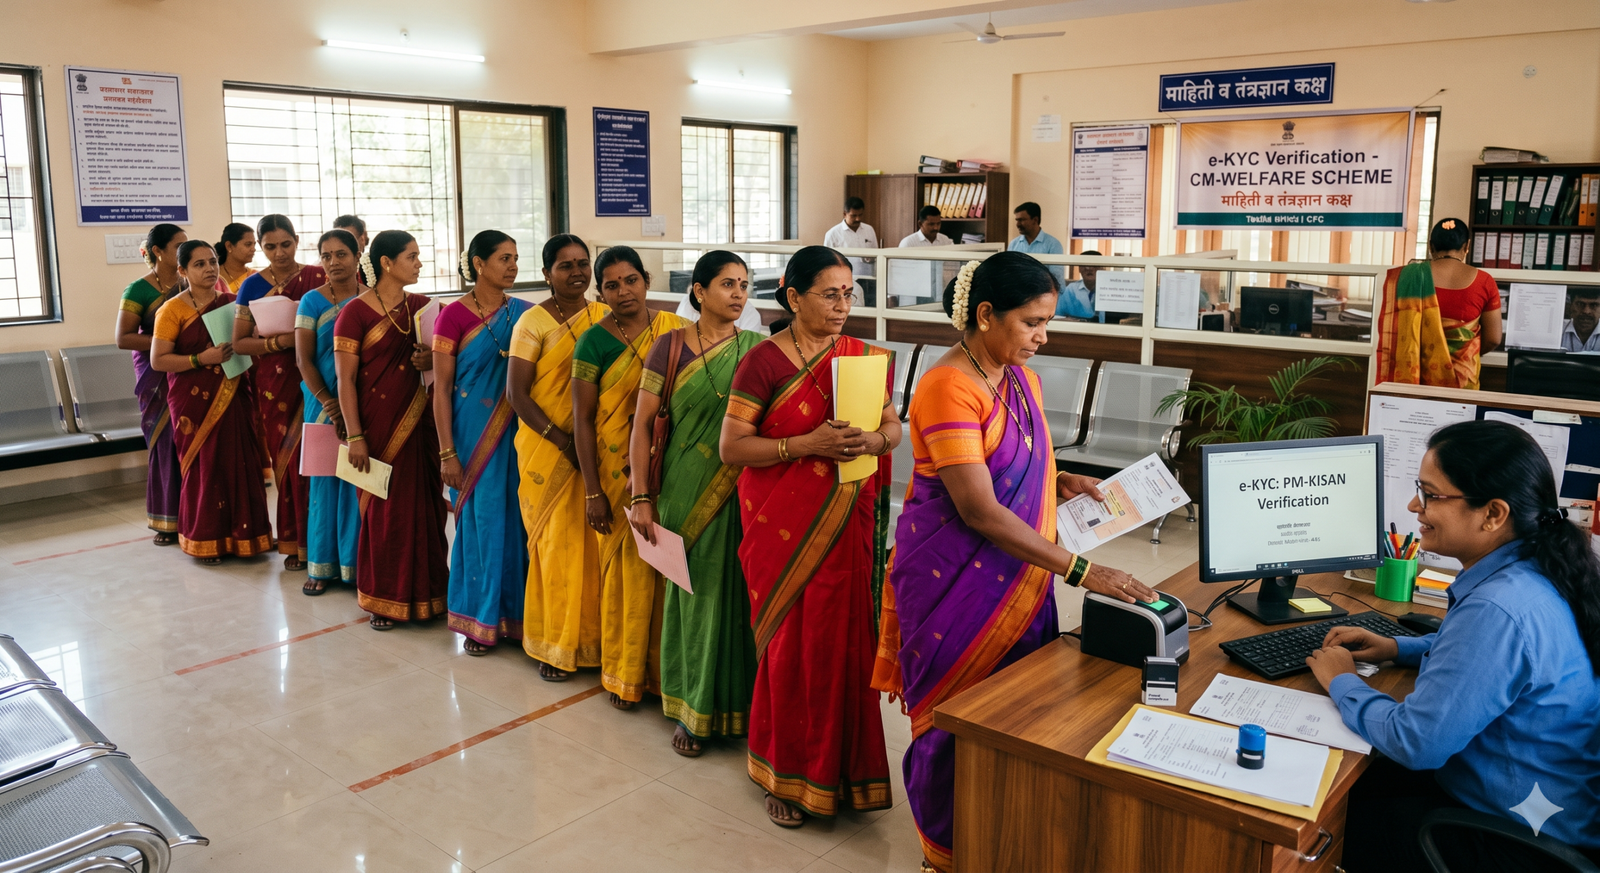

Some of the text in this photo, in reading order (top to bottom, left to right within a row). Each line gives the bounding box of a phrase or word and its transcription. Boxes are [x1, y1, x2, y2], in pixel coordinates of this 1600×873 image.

[1166, 76, 1326, 103] माहिती व तंत्रज्ञान कक्ष
[1208, 151, 1260, 167] e-KYC
[1265, 149, 1366, 166] Verification
[1190, 169, 1393, 187] CM-WELFARE SCHEME
[1221, 191, 1353, 209] माहिती व तंत्रज्ञान कक्ष
[1306, 215, 1324, 224] CFC
[1239, 473, 1346, 492] e-KYC: PM-KISAN
[1257, 494, 1329, 510] Verification
